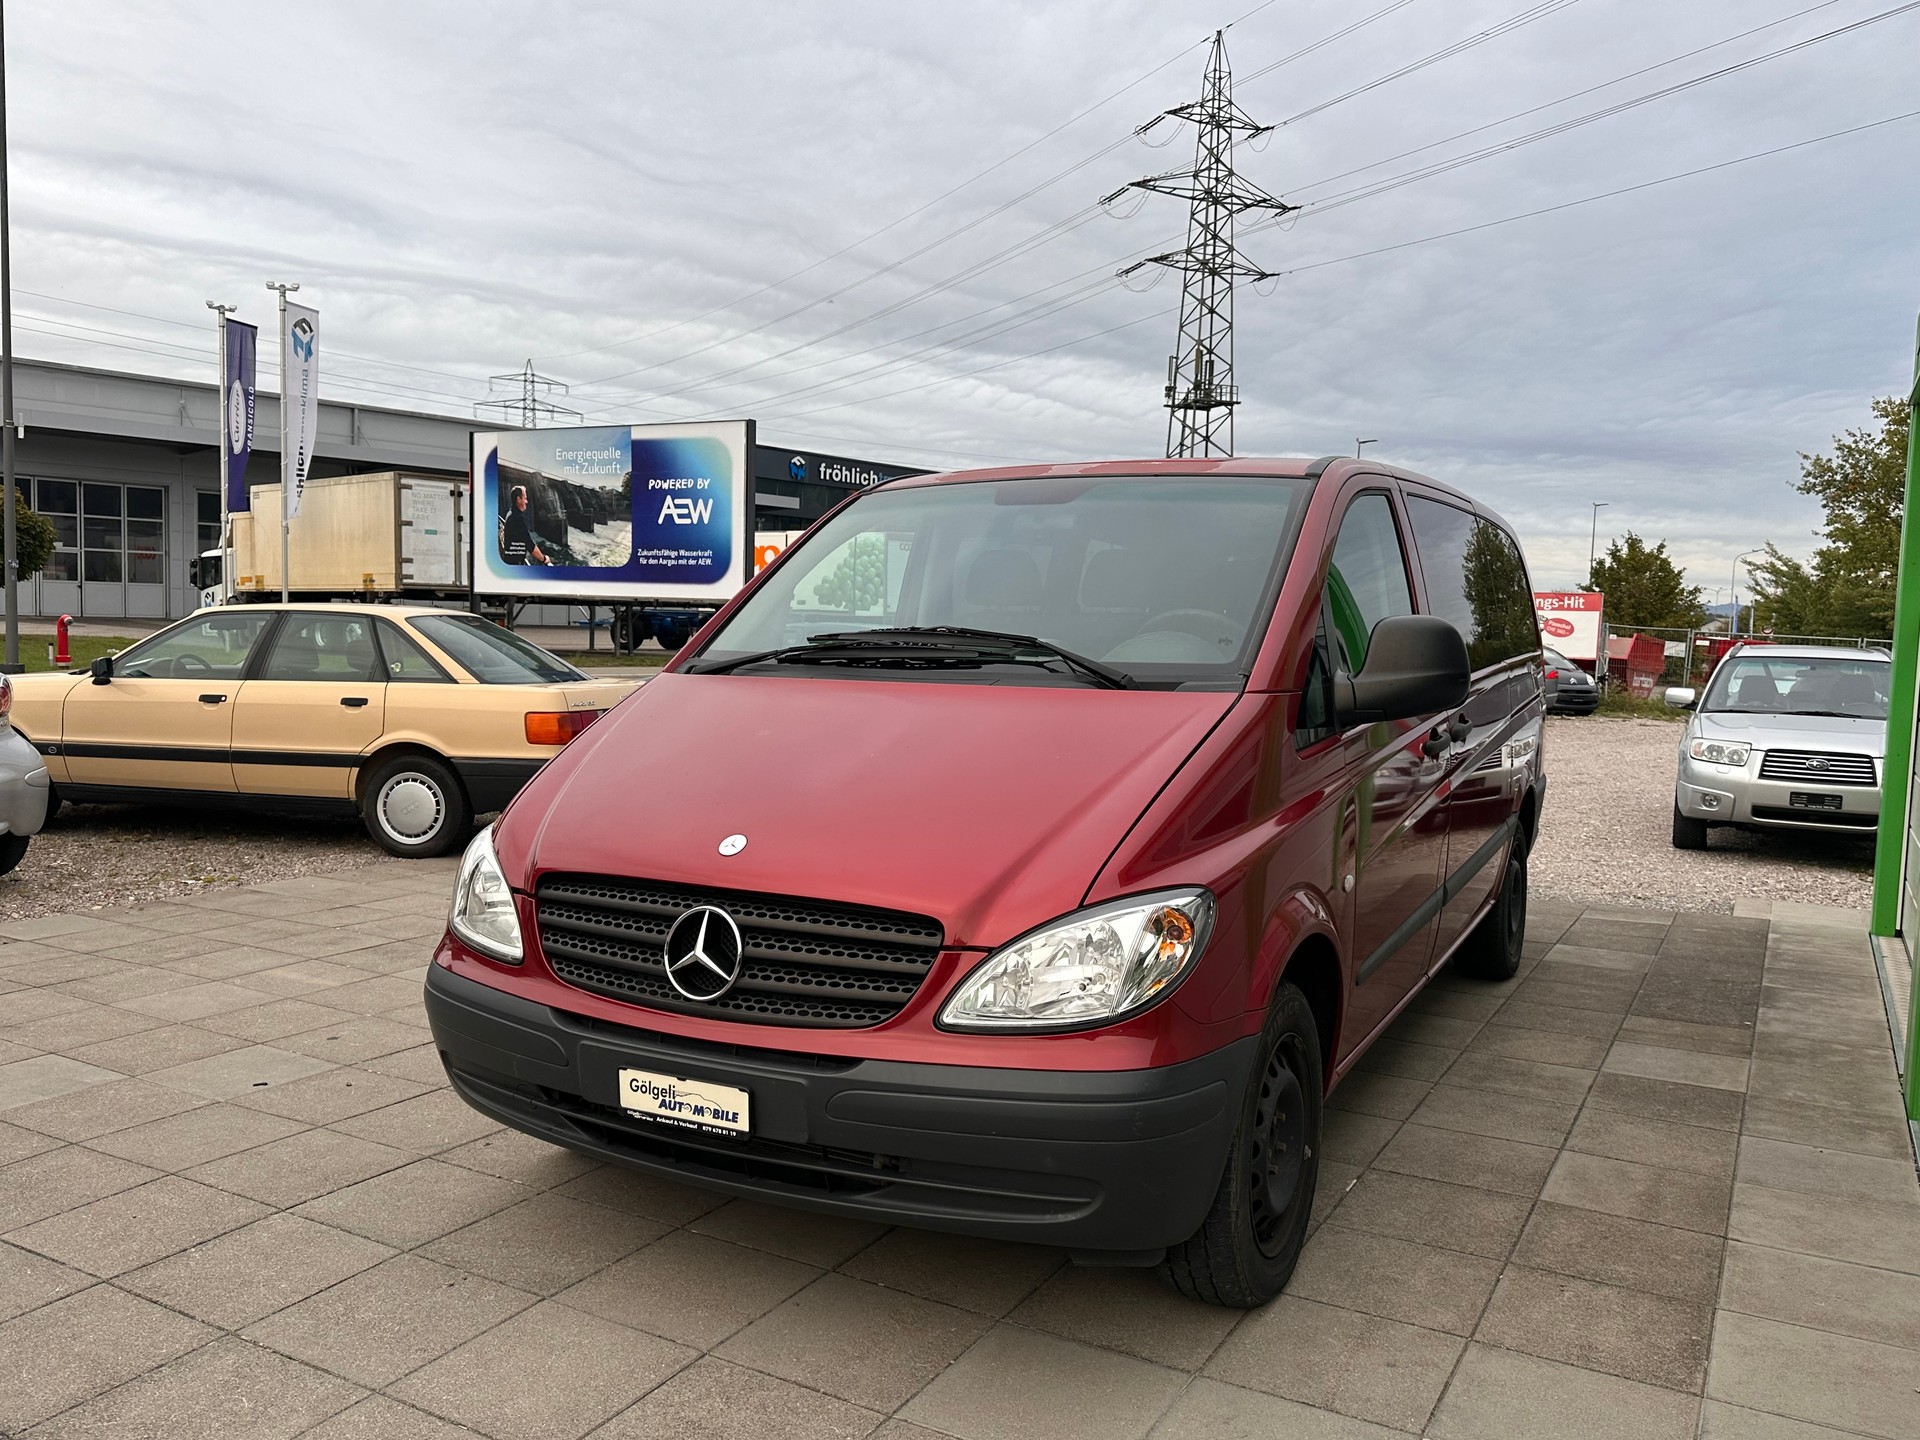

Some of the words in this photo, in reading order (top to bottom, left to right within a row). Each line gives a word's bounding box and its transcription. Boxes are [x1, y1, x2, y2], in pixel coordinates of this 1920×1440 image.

[247, 386, 255, 453] TRANSICOLD
[555, 446, 621, 463] Energiequelle
[564, 463, 580, 475] mit
[582, 462, 621, 474] Zukunft
[819, 462, 878, 486] fröhlich
[648, 478, 694, 490] POWERED
[697, 477, 711, 489] BY
[411, 491, 421, 499] NO
[423, 492, 450, 502] MATTER
[657, 494, 714, 525] AEW
[637, 548, 678, 558] Zukunftsfähige
[679, 549, 713, 557] Wasserkraft
[639, 557, 647, 565] für
[648, 557, 658, 565] den
[659, 558, 677, 567] Aargau
[698, 558, 713, 566] AEW.
[629, 1077, 676, 1101] Gölgeli
[658, 1098, 739, 1124] AUTOMOBILE
